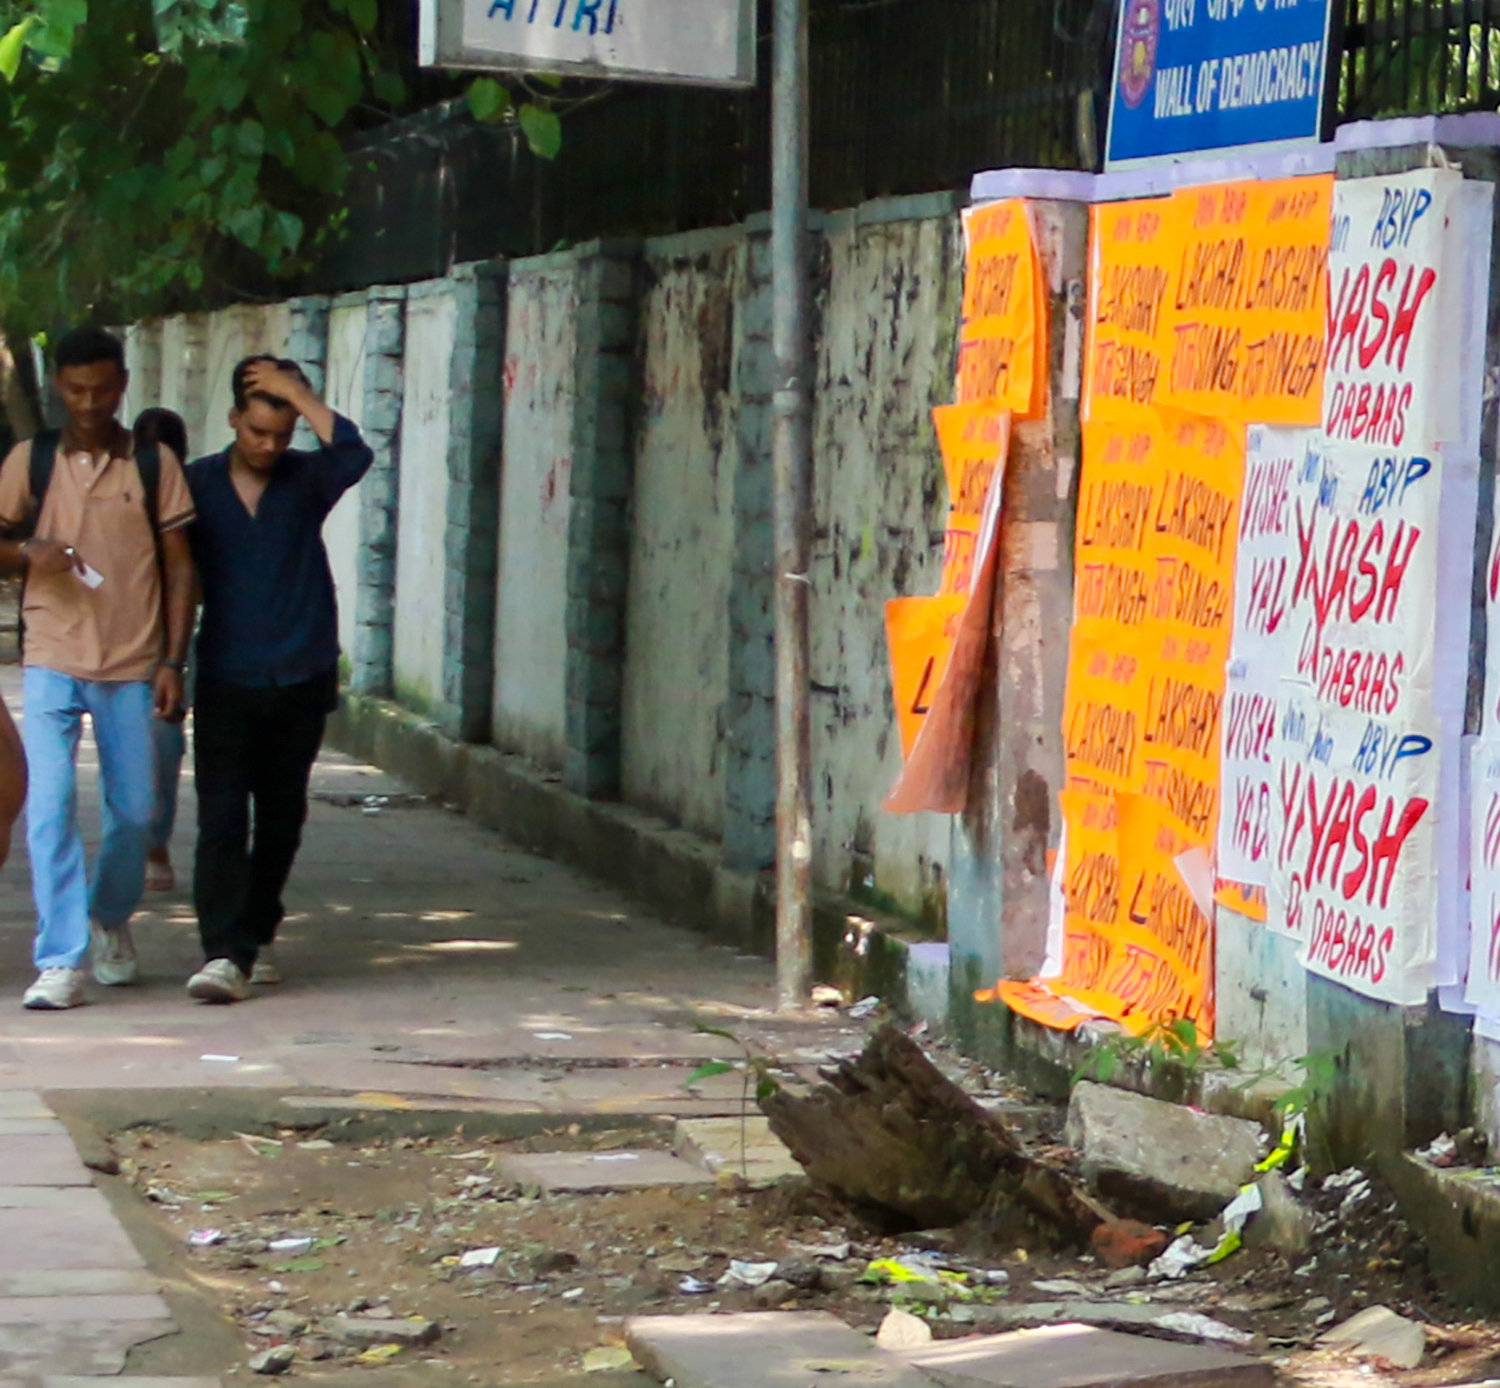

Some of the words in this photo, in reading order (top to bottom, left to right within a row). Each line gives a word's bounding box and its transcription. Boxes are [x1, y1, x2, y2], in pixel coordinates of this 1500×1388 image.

[1154, 66, 1193, 118] WALL
[1197, 61, 1220, 112] OF
[1220, 40, 1320, 109] DEMOCRACY
[1369, 188, 1431, 248] ABVP
[1247, 241, 1326, 309] LAKSHAY
[1325, 381, 1412, 446] DABAAS
[1358, 457, 1431, 516] ABVP
[1317, 647, 1403, 714] DABAAS
[1353, 718, 1432, 779] ABVP
[1304, 773, 1428, 908] YASH
[1305, 899, 1394, 983] DABAAS
